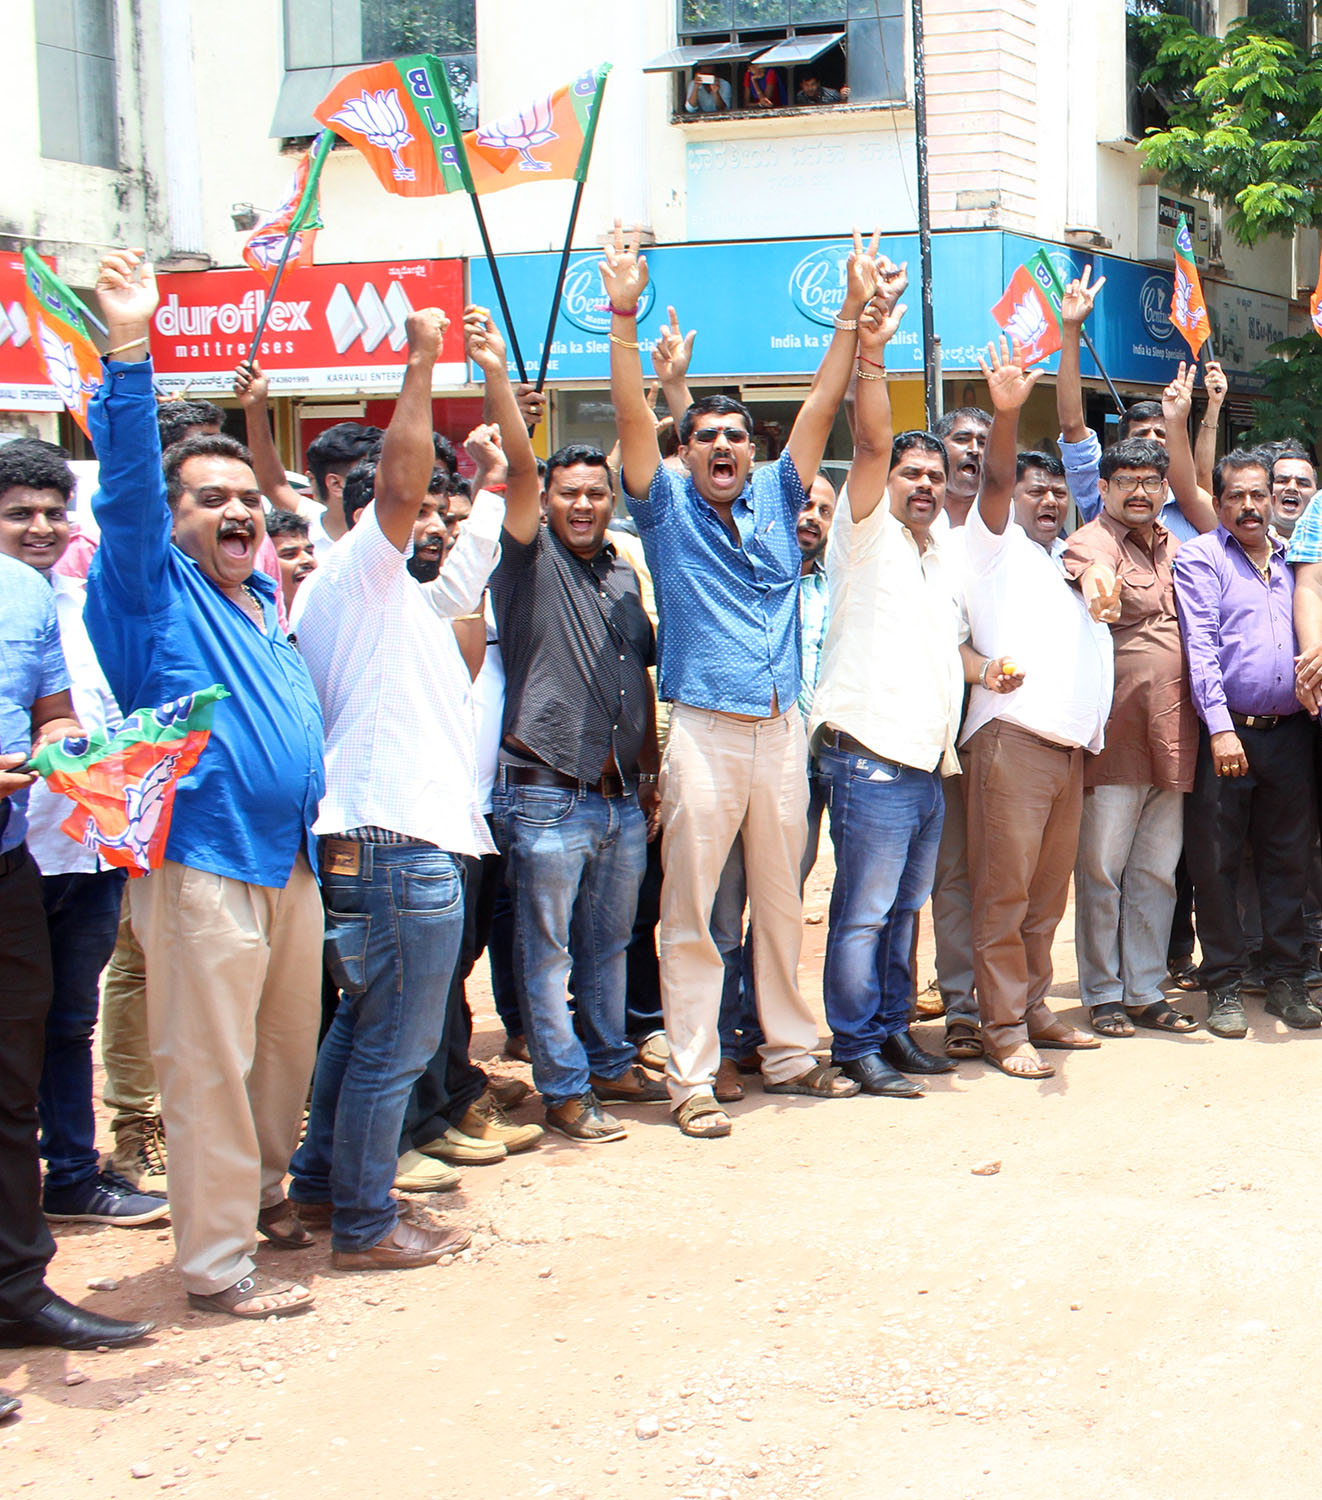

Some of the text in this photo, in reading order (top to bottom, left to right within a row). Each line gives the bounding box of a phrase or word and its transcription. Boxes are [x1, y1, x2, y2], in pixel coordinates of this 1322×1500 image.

[155, 290, 312, 336] duroflex
[539, 339, 609, 354] Idia ka Slee
[771, 334, 801, 348] India
[804, 334, 819, 347] ka
[175, 341, 294, 357] mattreses
[327, 373, 367, 382] KARAVALI
